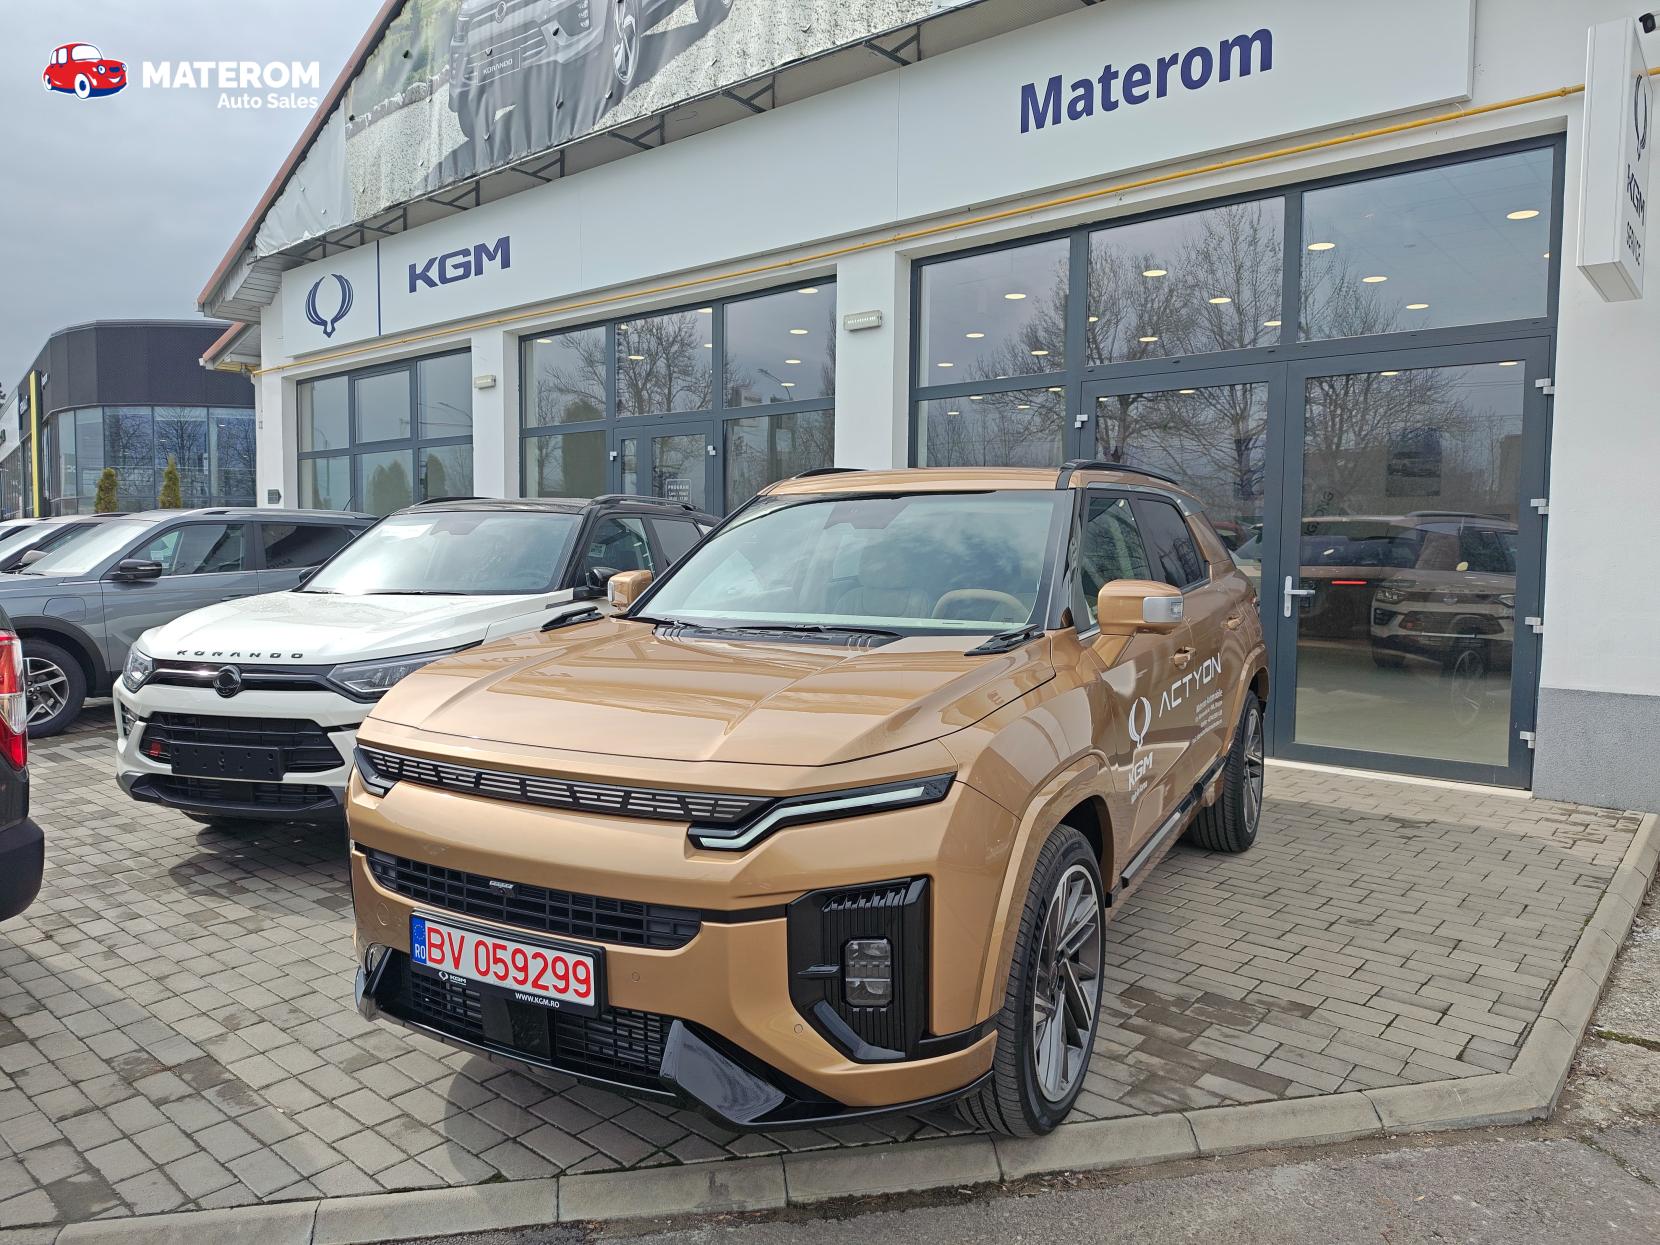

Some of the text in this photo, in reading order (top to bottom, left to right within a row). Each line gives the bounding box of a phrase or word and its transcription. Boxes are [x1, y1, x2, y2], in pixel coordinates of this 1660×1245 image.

[1020, 28, 1273, 134] Materom
[1627, 163, 1646, 226] KGM
[408, 235, 511, 293] KGM
[177, 649, 303, 659] KORANDO
[1159, 652, 1222, 718] ACTYON
[1128, 752, 1153, 791] KGM
[415, 943, 426, 960] RO
[427, 926, 592, 999] BV 059299
[515, 991, 560, 1009] WWW.KGM.RO
